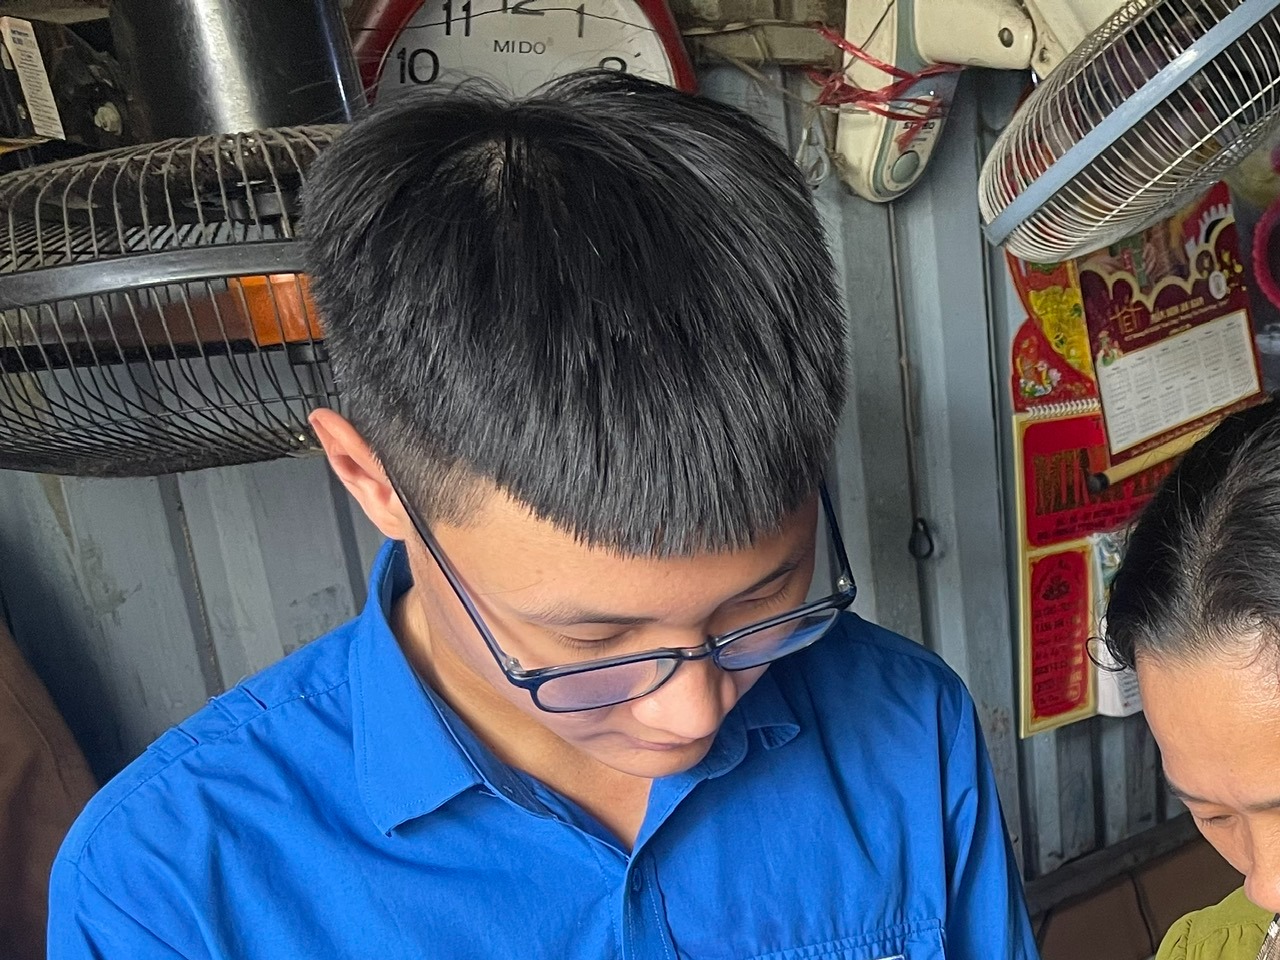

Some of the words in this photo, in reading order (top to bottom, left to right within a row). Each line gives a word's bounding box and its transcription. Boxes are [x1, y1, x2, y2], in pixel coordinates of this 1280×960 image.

[442, 0, 471, 36] 11
[576, 3, 585, 38] 1
[493, 40, 546, 54] MIDO
[397, 47, 439, 85] 10
